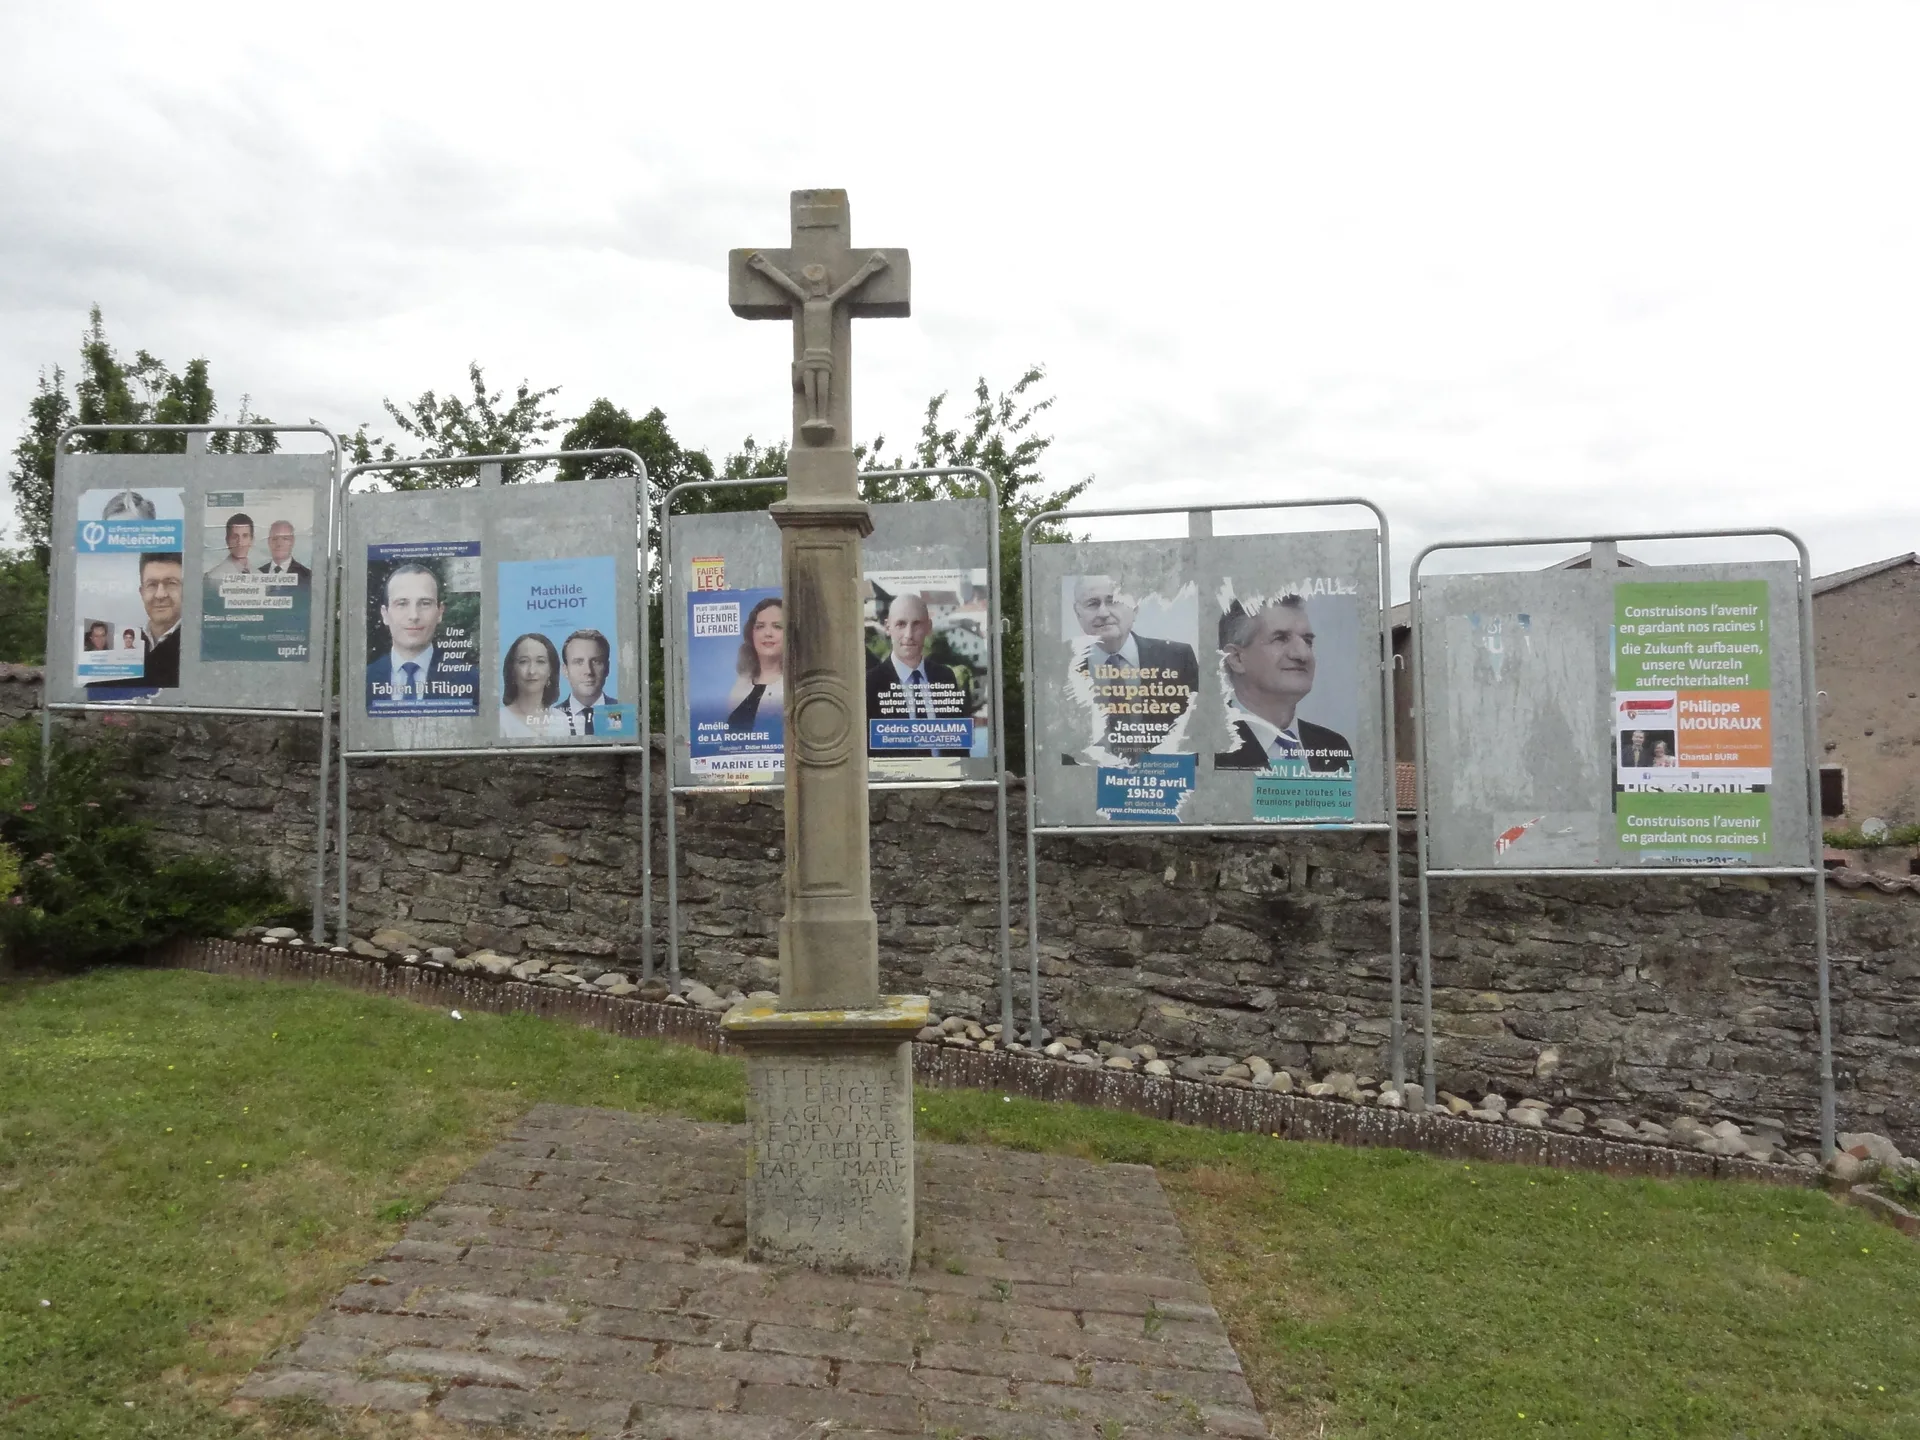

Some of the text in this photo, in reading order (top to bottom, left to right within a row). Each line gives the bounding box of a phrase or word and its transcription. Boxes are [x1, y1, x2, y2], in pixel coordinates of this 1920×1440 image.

[108, 534, 175, 545] Mélenchon
[697, 567, 720, 576] FAIRE
[261, 575, 277, 583] seul
[698, 576, 713, 588] LE
[531, 584, 583, 596] Mathilde
[272, 597, 291, 606] utile
[527, 597, 587, 610] HUCHOT
[1625, 604, 1758, 617] Construisons l'avenir
[697, 612, 738, 623] DÉFENDRE
[446, 627, 464, 636] Une
[696, 624, 738, 634] LA FRANCE
[1620, 624, 1635, 633] en
[1638, 622, 1684, 635] gardant
[1688, 623, 1709, 632] nos
[1713, 620, 1756, 632] racines
[437, 639, 472, 648] volonté
[1621, 642, 1763, 655] die Zukunft aufbauen,
[278, 645, 307, 658] upr.fr
[443, 651, 466, 661] pour
[437, 662, 472, 672] l'avenir
[1642, 658, 1742, 670] unsere Wurzeln
[1095, 664, 1159, 679] libérer
[1162, 669, 1178, 678] de
[1636, 674, 1749, 686] aufrechterhalten!
[372, 681, 473, 696] Fabien Di Filippo
[1680, 700, 1740, 715] Philippe
[526, 715, 540, 725] En
[1680, 717, 1762, 730] MOURAUX
[698, 722, 729, 730] Amélie
[876, 724, 967, 733] Cédric SOUALMIA
[1115, 721, 1169, 733] Jacques
[724, 732, 769, 741] ROCHERE
[914, 735, 961, 743] CALCATERA
[1280, 748, 1351, 758] Le temps est venu.
[1680, 753, 1712, 761] Chantal
[712, 761, 753, 769] MARINE
[757, 760, 769, 768] LE
[1105, 776, 1187, 787] Mardi 18 avril
[1127, 788, 1164, 799] 19h30
[1257, 787, 1352, 796] Retrouvez toutes les
[1257, 798, 1291, 806] réunions
[1295, 799, 1335, 808] publiques
[1627, 815, 1761, 828] Construisons l'avenir
[1622, 833, 1637, 843] en
[1640, 832, 1687, 845] gardant
[1690, 833, 1712, 843] nos
[1716, 832, 1759, 844] racines
